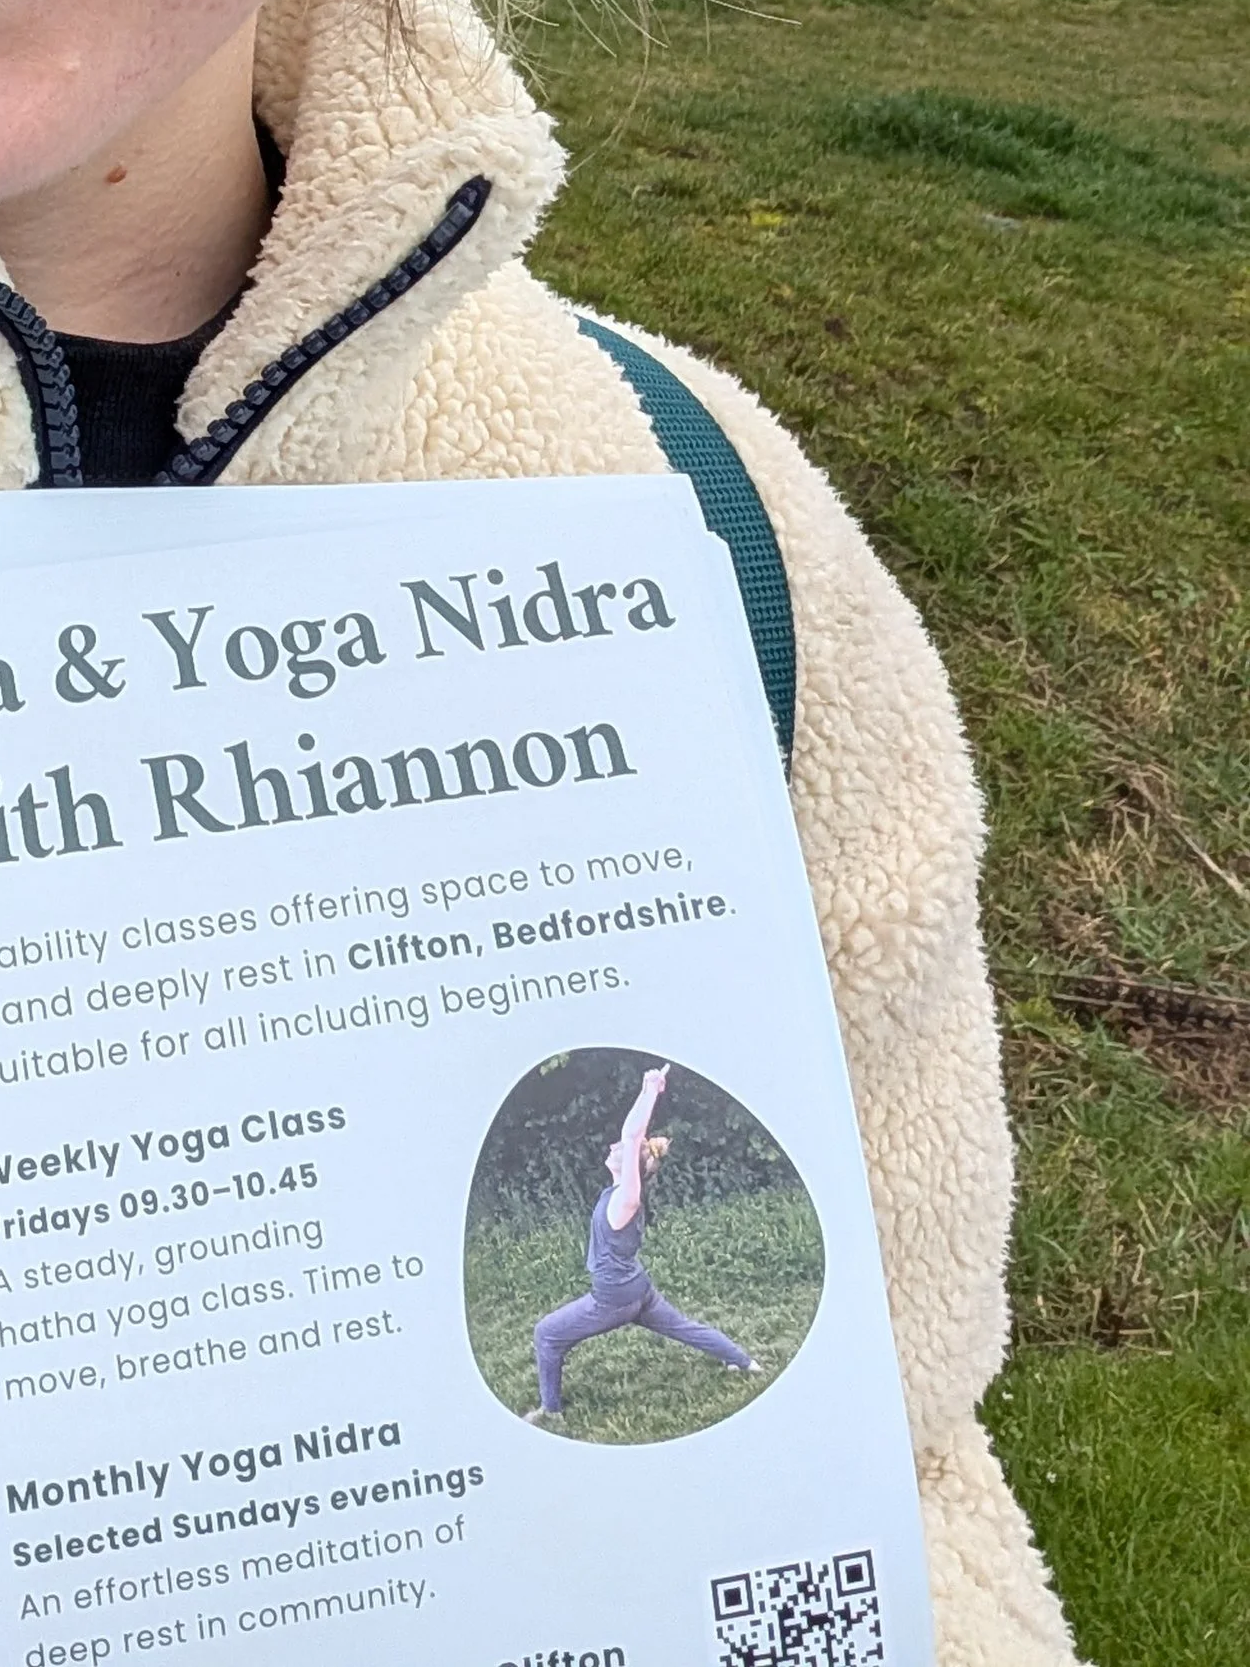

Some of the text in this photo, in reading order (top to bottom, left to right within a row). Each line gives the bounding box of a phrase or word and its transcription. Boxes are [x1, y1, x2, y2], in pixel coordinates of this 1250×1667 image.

[55, 625, 126, 703] &
[142, 605, 387, 699] Yoga
[400, 561, 676, 659] Nidra
[140, 723, 637, 841] Rhiannon
[123, 910, 256, 949] classes
[270, 886, 409, 926] offering
[422, 870, 528, 911] space
[539, 861, 574, 886] to
[587, 848, 692, 880] move,
[2, 986, 72, 1024] and
[87, 968, 209, 1011] deeply
[224, 955, 293, 991] rest
[303, 949, 335, 978] in
[348, 933, 482, 970] Clifton,
[492, 892, 736, 949] Bedfordshire.
[141, 1030, 189, 1061] for
[205, 1016, 246, 1050] all
[259, 995, 429, 1042] including
[440, 967, 629, 1015] beginners.
[130, 1125, 230, 1163] Yoga
[242, 1107, 345, 1143] Class
[24, 1248, 143, 1289] steady,
[155, 1220, 322, 1275] grounding
[107, 1296, 189, 1337] yoga
[202, 1280, 293, 1311] class.
[303, 1264, 381, 1294] Time
[392, 1255, 423, 1279] to
[6, 1310, 402, 1400] move, breathe and rest.
[6, 1422, 401, 1514] Monthly Yoga Nidra
[13, 1466, 484, 1567] Selected Sundays evenings
[21, 1514, 464, 1620] An effortless meditation of
[26, 1579, 435, 1667] deep rest in community.
[498, 1647, 625, 1667] ifton
